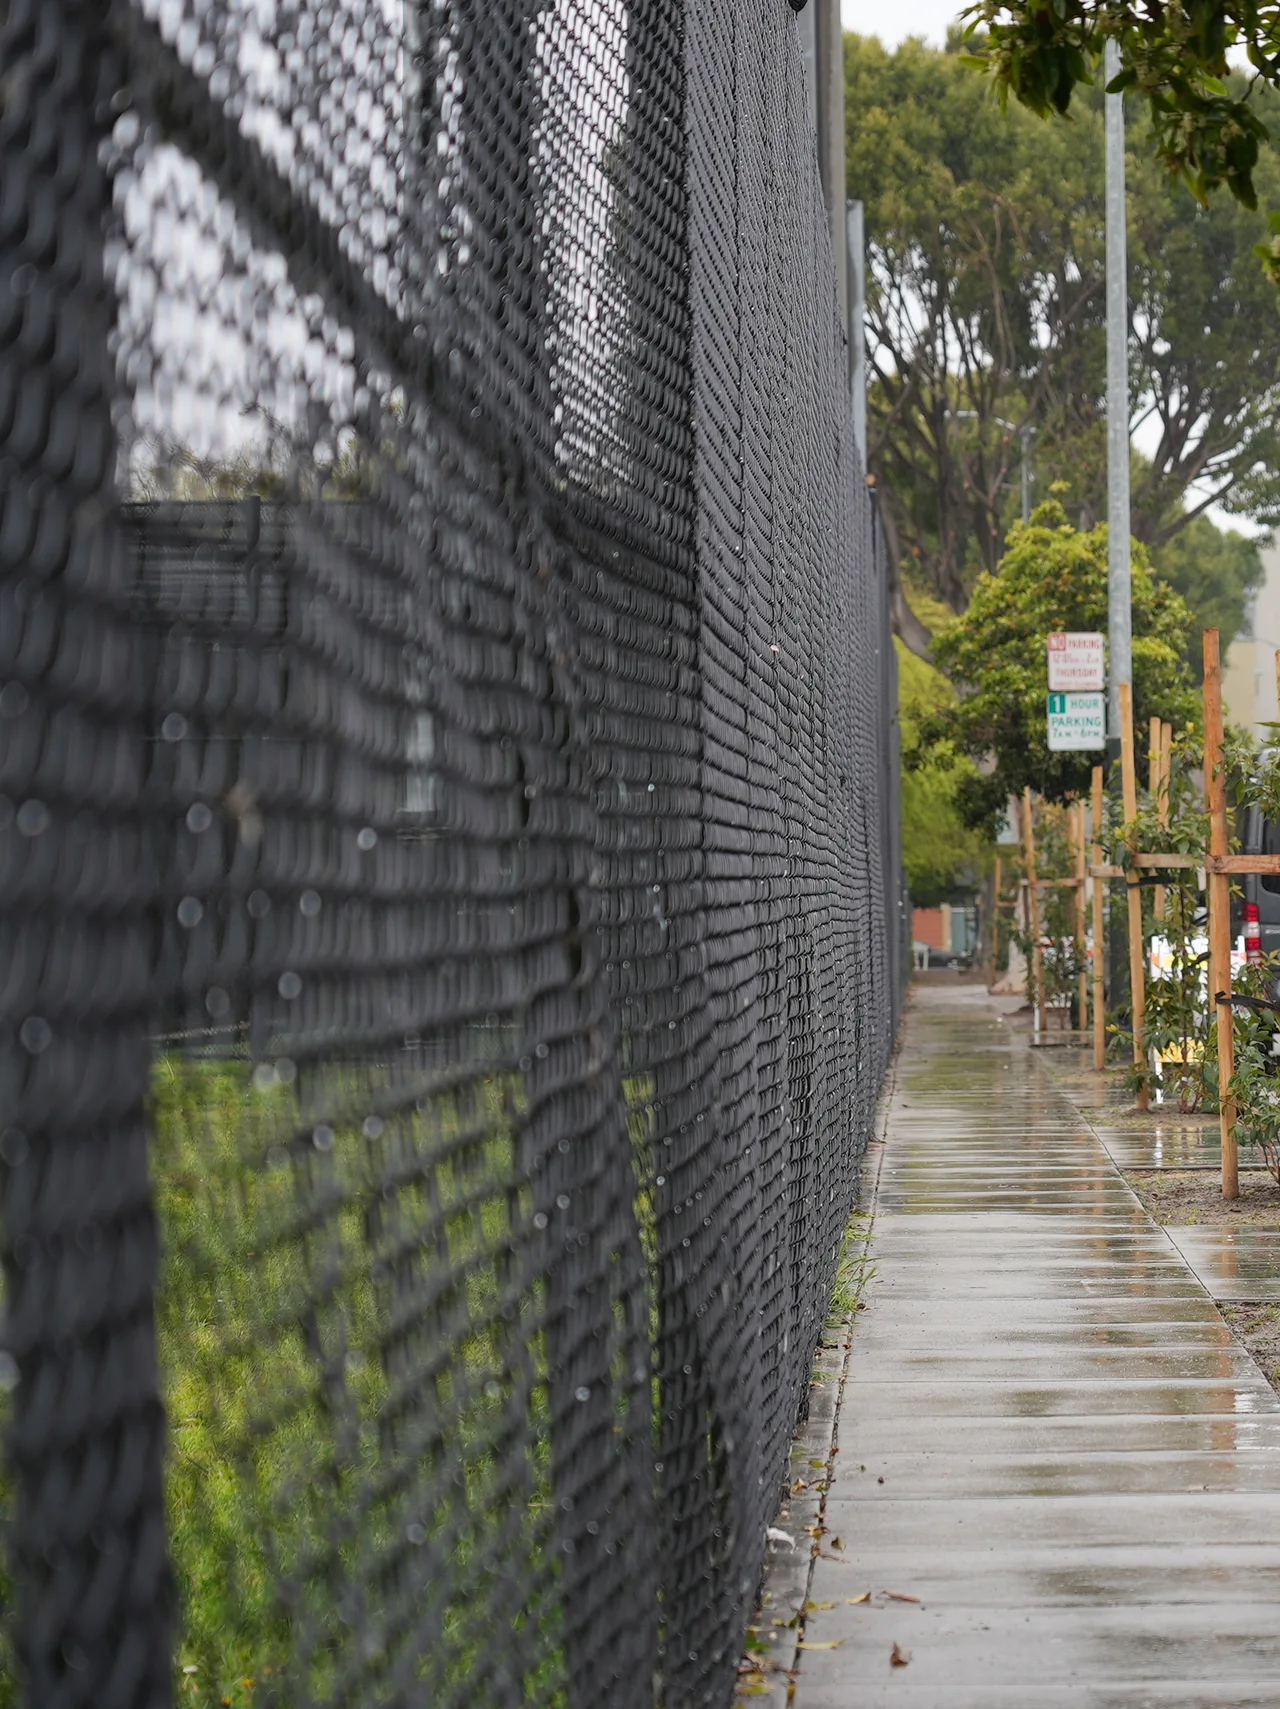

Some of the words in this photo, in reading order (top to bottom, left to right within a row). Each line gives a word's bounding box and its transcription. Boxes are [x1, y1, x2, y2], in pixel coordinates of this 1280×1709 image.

[1053, 696, 1060, 713] 1
[1071, 698, 1099, 709] HOUR
[1052, 716, 1101, 727] PARKING
